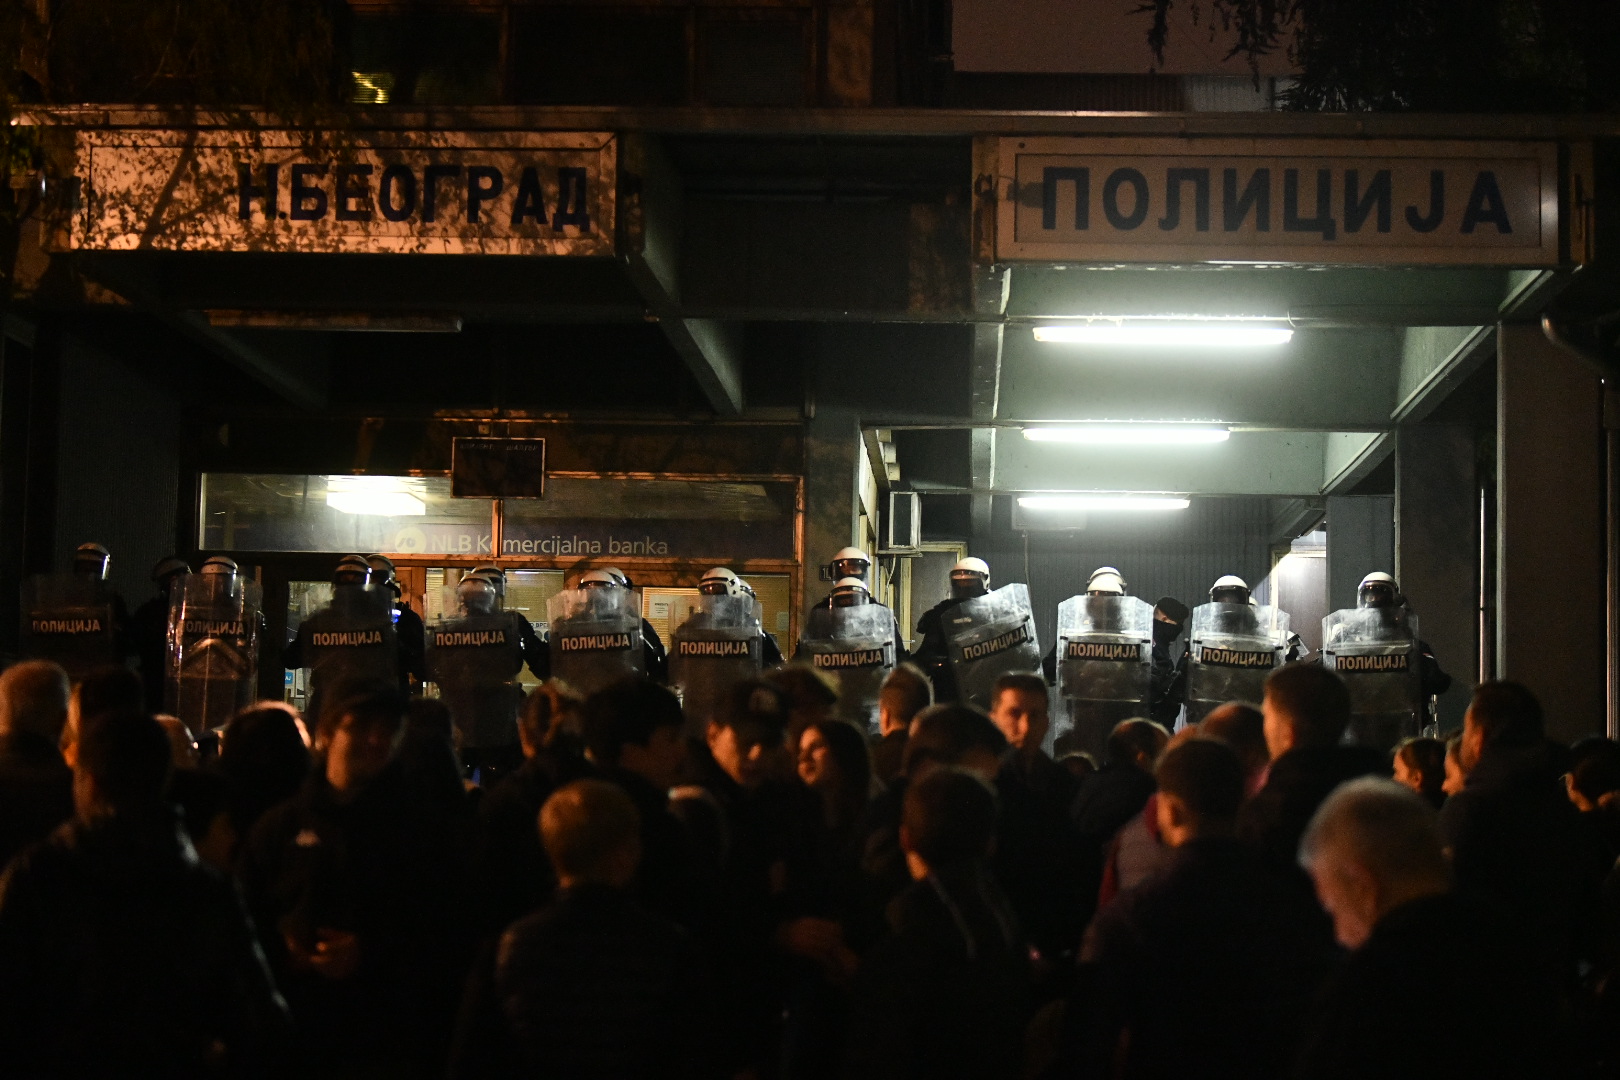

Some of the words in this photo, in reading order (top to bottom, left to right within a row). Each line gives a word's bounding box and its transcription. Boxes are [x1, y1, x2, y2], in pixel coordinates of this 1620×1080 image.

[1043, 168, 1512, 241] ПОЛИЦИЈА
[432, 535, 471, 552] NLB
[476, 535, 601, 555] Kmercijalna
[609, 536, 668, 555] banka
[184, 620, 244, 636] ОЛИЦИЈА
[313, 632, 383, 647] ПОЛИЦИЈА
[436, 632, 505, 647] ПОЛИЦИЈА
[561, 634, 630, 651] ПОЛИЦИЈА
[964, 626, 1026, 660] ПОЛИЦИЈА
[680, 641, 749, 657] ПОЛИЦИЈА
[1069, 643, 1138, 659] ПОЛИЦИЈА
[1203, 647, 1272, 667] ПОЛИЦИЈА
[813, 651, 882, 667] ПОЛИЦИЈА
[1337, 656, 1407, 671] ПОЛИЦИЈА
